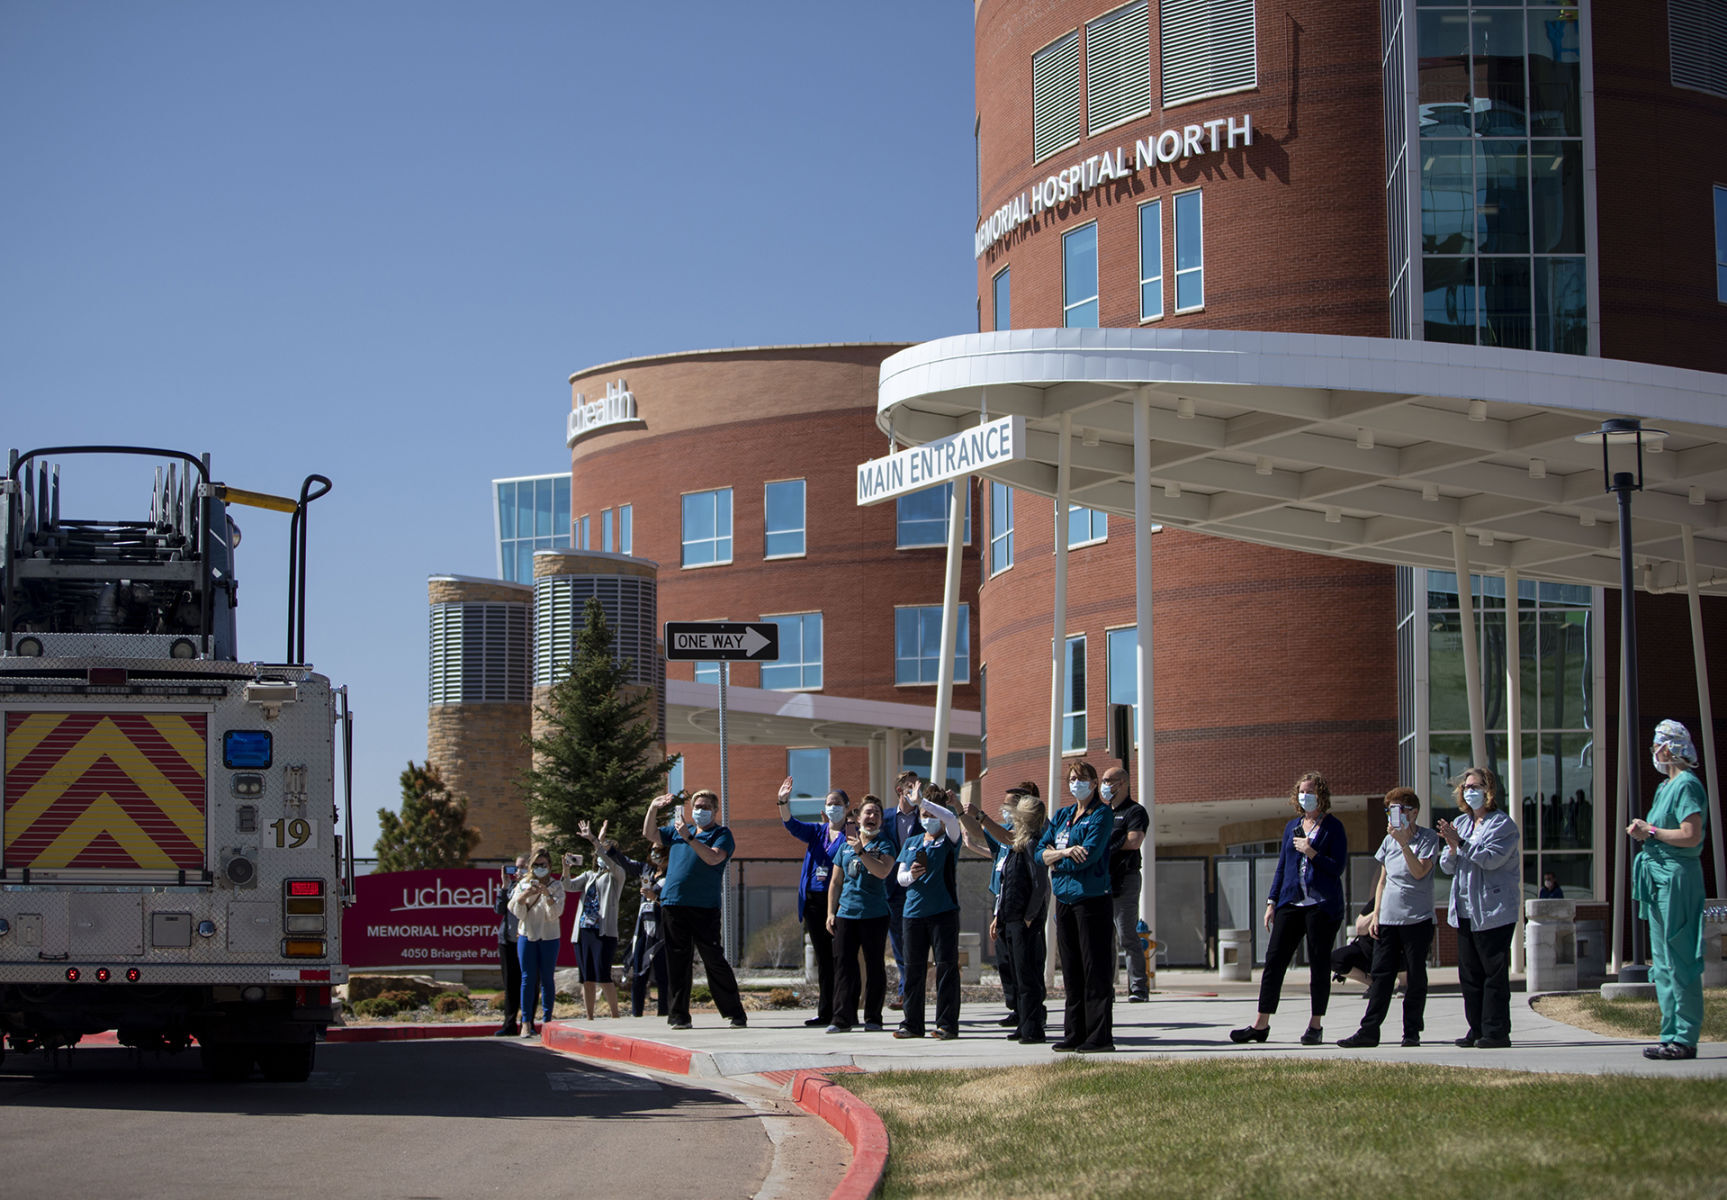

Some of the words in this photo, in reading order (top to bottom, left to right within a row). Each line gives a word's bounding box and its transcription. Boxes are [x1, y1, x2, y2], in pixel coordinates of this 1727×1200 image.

[975, 192, 1031, 260] MEMORIAL
[1032, 147, 1132, 215] HOSPITAL
[1136, 113, 1253, 171] NORTH
[859, 457, 903, 499] MAIN
[911, 423, 1010, 484] ENTRANCE
[678, 634, 707, 648] ONE
[712, 634, 744, 648] WAY
[270, 818, 311, 848] 19
[403, 878, 502, 908] uchealt
[367, 925, 439, 937] MEMORIAL
[442, 925, 500, 937] HOSPITA
[401, 948, 428, 958] 4050
[431, 948, 478, 961] Briargate
[480, 948, 500, 958] Par
